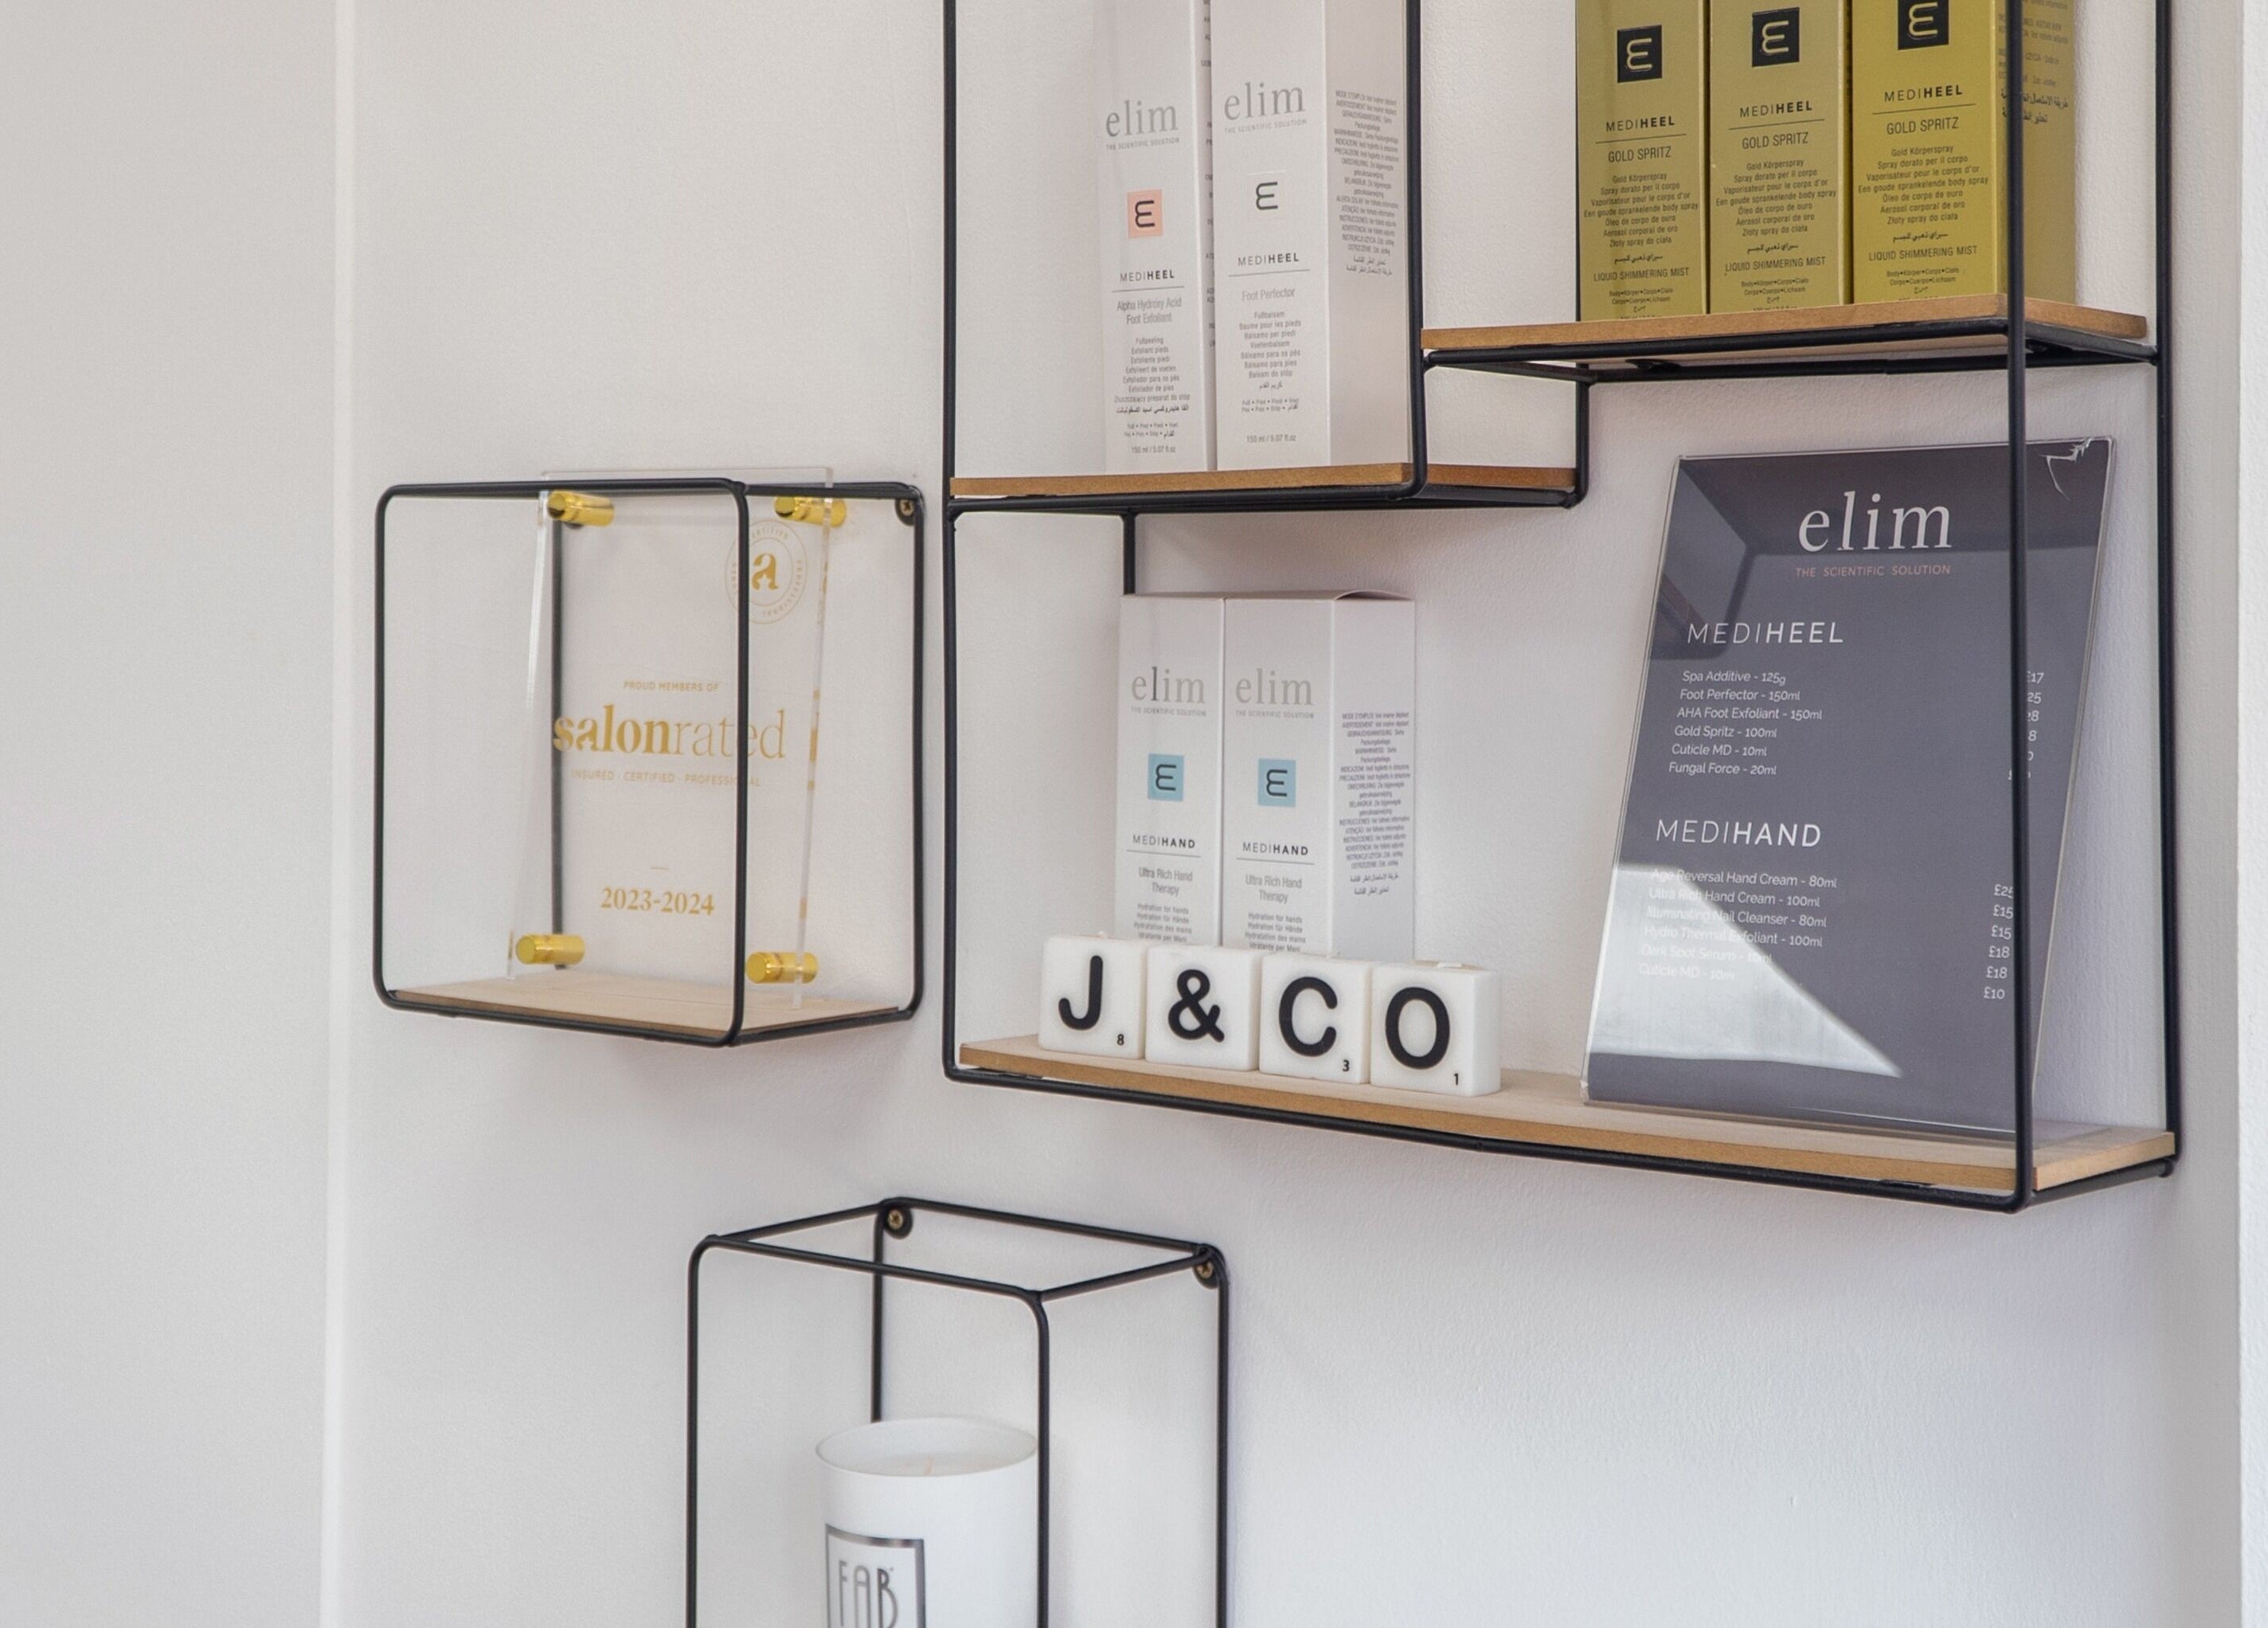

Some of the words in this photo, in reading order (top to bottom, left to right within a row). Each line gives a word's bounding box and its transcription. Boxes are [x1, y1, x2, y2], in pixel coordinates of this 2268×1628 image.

[1885, 84, 1962, 102] MEDIHEEL
[1224, 81, 1304, 120] elim
[1740, 100, 1812, 118] MEDIHEEL
[1106, 100, 1178, 138] elim
[1238, 123, 1272, 132] SCIENTIFIC
[1274, 119, 1307, 129] SOLUTION
[1606, 115, 1675, 132] MEDIHEEL
[1887, 121, 1916, 135] GOLD
[1920, 117, 1959, 132] SPRITZ
[1118, 140, 1148, 150] SCIENTIFIC
[1150, 137, 1179, 147] SOLUTION
[1742, 135, 1769, 150] GOLD
[1773, 132, 1809, 147] SPRITZ
[1609, 150, 1633, 162] GOLD
[1637, 146, 1671, 159] SPRITZ
[1891, 148, 1907, 157] Gold
[1878, 161, 1897, 170] Spray
[1867, 172, 1911, 182] Vaporisateur
[1941, 167, 1962, 176] corps
[1874, 184, 1895, 194] goude
[1898, 180, 1945, 191] sprankelende
[1949, 177, 1966, 186] body
[1969, 177, 1988, 186] spray
[1912, 192, 1933, 202] corpo
[1880, 205, 1906, 213] Aerosol
[1909, 202, 1939, 212] corporal
[1907, 215, 1927, 224] spray
[1238, 252, 1299, 267] MEDIHEEL
[1869, 251, 1896, 261] LIQUID
[1899, 247, 1953, 259] SHIMMERING
[1957, 245, 1977, 255] MIST
[1726, 262, 1750, 272] LIQUID
[1754, 258, 1803, 269] SHIMMERING
[1806, 256, 1826, 266] MIST
[1120, 270, 1174, 282] MEDIHEEL
[1594, 272, 1617, 282] LIQUID
[1620, 268, 1668, 280] SHIMMERING
[1671, 268, 1689, 276] MIST
[1242, 291, 1258, 301] Foot
[1261, 288, 1295, 300] Perfector
[1117, 301, 1136, 311] Alpha
[1137, 299, 1164, 311] Hydroxy
[1166, 297, 1182, 308] Acid
[1127, 315, 1141, 325] Foot
[1143, 313, 1171, 323] Exfoliant
[1798, 490, 1952, 553] elim
[752, 554, 779, 590] a
[1796, 567, 1816, 577] THE
[1824, 565, 1885, 577] SCIENTIFIC
[1892, 564, 1951, 576] SOLUTION
[1687, 622, 1844, 644] MEDIHEEL
[1132, 667, 1206, 703] elim
[1682, 671, 1703, 683] Spa
[1706, 671, 1751, 682] Additive
[1762, 672, 1785, 686] 125g
[624, 680, 655, 691] PROUD
[659, 681, 703, 692] MEMBERS
[1236, 668, 1314, 706] elim
[1680, 689, 1703, 700] Foot
[1707, 689, 1758, 700] Perfector
[1769, 691, 1801, 702] 150ml
[1676, 707, 1702, 718] AHA
[1704, 707, 1729, 718] Foot
[1732, 707, 1780, 719] Exfoliant
[1790, 710, 1823, 721] 150ml
[1675, 725, 1701, 737] Gold
[1703, 726, 1734, 738] Spritz
[1746, 728, 1777, 738] 100ml
[1672, 743, 1710, 755] Cuticle
[1712, 745, 1731, 756] MD
[1742, 746, 1767, 756] 10ml
[572, 769, 614, 780] INSURED
[624, 772, 675, 783] CERTIFIED
[1668, 762, 1706, 776] Fungal
[1708, 762, 1739, 774] Force
[1750, 765, 1777, 775] 20ml
[1656, 820, 1821, 847] MEDIHAND
[1132, 835, 1195, 848] MEDIHAND
[1243, 842, 1308, 855] MEDIHAND
[1139, 867, 1155, 879] Ultra
[1157, 869, 1172, 879] Rich
[1174, 871, 1193, 882] Hand
[1676, 870, 1724, 883] Reversal
[1726, 872, 1757, 884] Hand
[1759, 873, 1797, 886] Cream
[1809, 876, 1837, 888] 80ml
[1245, 875, 1262, 886] Ultra
[1265, 875, 1281, 886] Rich
[1282, 877, 1302, 889] Hand
[1152, 882, 1179, 897] Therapy
[600, 886, 714, 915] 2023-2024
[1260, 890, 1288, 904] Therapy
[1705, 891, 1734, 903] Hand
[1738, 892, 1775, 905] Cream
[1787, 895, 1820, 907] 100ml
[1993, 905, 2013, 918] £15
[1738, 911, 1789, 925] Cleanser
[1799, 915, 1827, 927] 80ml
[1992, 925, 2011, 940] £15
[1789, 936, 1823, 947] 100ml
[1988, 945, 2010, 958] £18
[1986, 966, 2007, 979] £18
[1058, 956, 1103, 1031] J
[1984, 986, 2005, 1000] £10
[1116, 1034, 1124, 1046] 8
[1343, 1059, 1349, 1072] 3
[1453, 1074, 1459, 1086] 1
[839, 1560, 898, 1628] FAB
